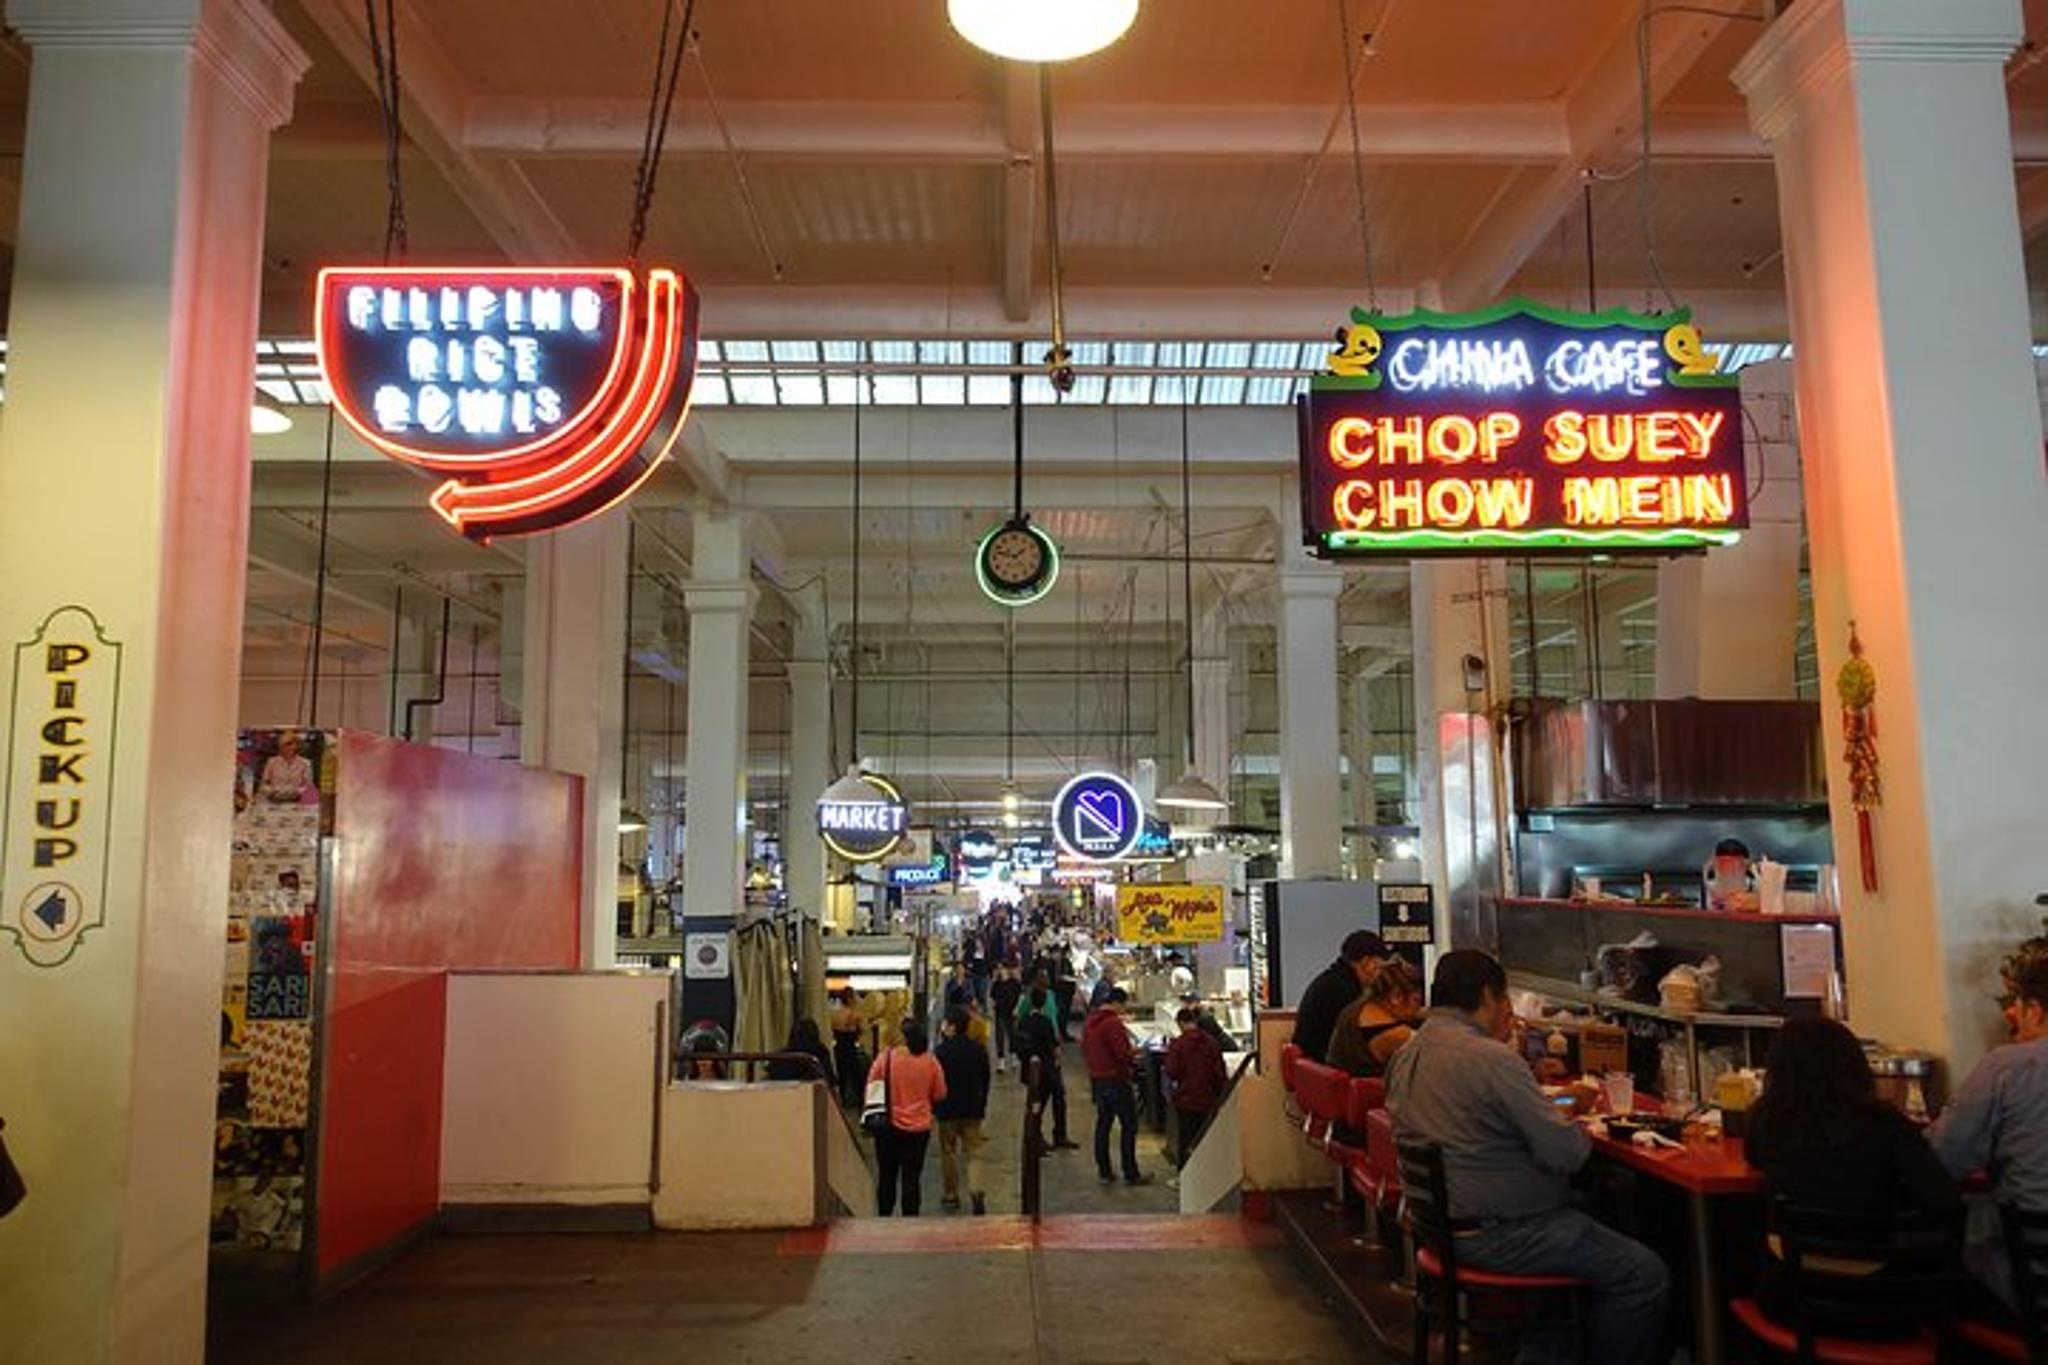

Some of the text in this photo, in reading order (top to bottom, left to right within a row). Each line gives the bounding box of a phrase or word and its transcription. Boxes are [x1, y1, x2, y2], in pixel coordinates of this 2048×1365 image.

[347, 285, 602, 331] FILIPINO
[407, 336, 540, 382] RICE
[1389, 339, 1662, 395] CHINA CAFE
[373, 384, 562, 433] BOWLS
[1328, 410, 1724, 470] CHOP SUEY
[1332, 473, 1735, 530] CHOW MEIN
[33, 643, 90, 868] PICKUP
[820, 806, 905, 832] MARKET
